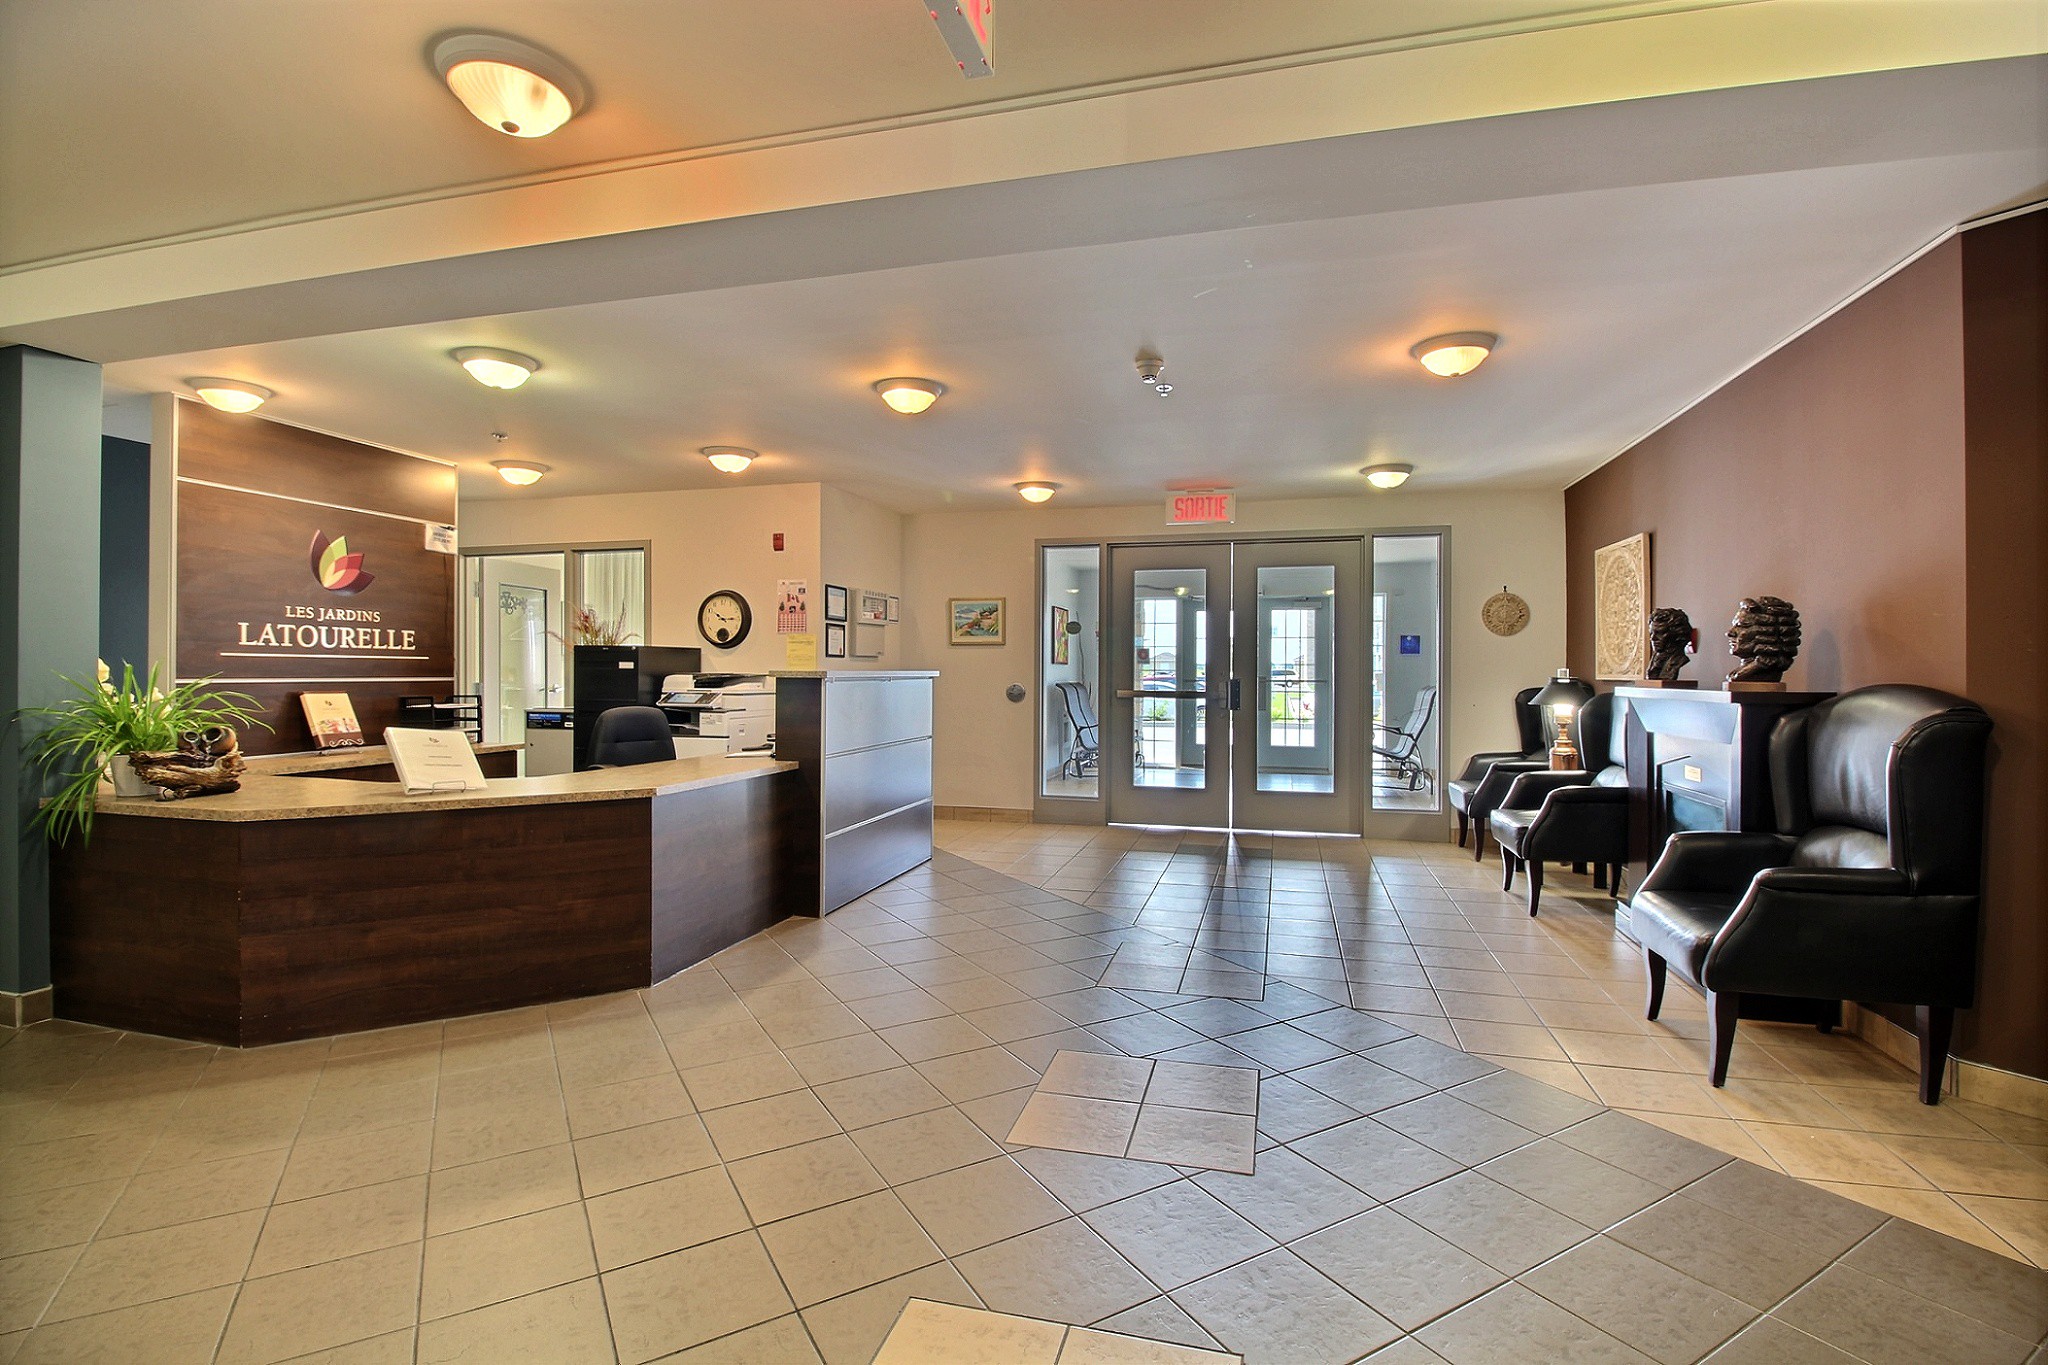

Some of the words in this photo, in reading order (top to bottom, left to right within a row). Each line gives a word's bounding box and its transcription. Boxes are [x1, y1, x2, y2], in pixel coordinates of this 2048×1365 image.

[1174, 495, 1229, 522] SORTIE
[285, 605, 315, 619] LES
[317, 607, 381, 623] JARDINS
[237, 622, 416, 651] LATOURELLE
